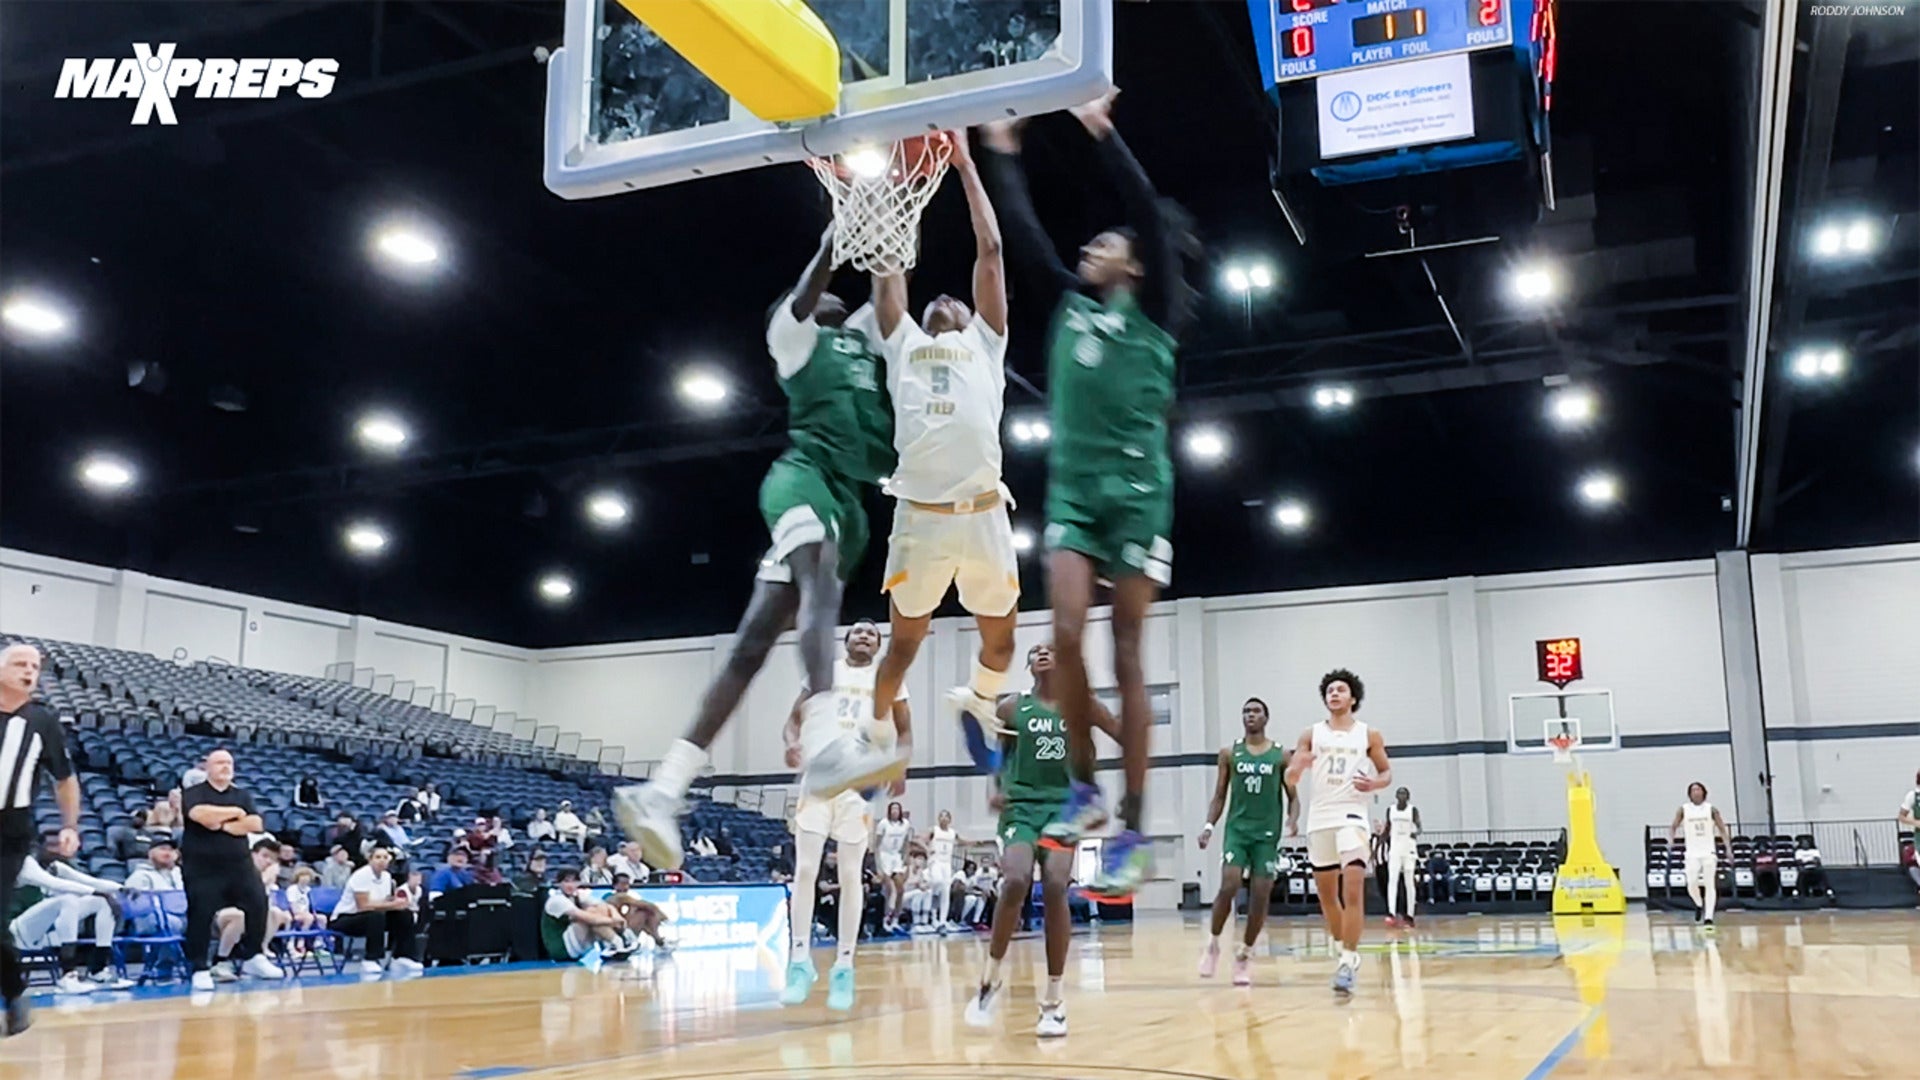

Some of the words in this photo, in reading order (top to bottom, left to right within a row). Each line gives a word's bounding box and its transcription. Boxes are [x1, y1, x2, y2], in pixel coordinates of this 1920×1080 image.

[1367, 0, 1407, 14] MATCH
[1292, 11, 1328, 26] SCORE
[1292, 27, 1311, 57] 0
[1466, 27, 1505, 45] FOULS
[1352, 46, 1393, 64] PLAYER
[1402, 41, 1431, 55] FOUL
[1281, 59, 1317, 75] FOULS
[1394, 82, 1453, 98] Engineers
[931, 366, 950, 395] 5
[1546, 654, 1572, 676] 32
[1035, 736, 1066, 760] 23
[1328, 756, 1346, 774] 13
[1244, 775, 1262, 794] 11
